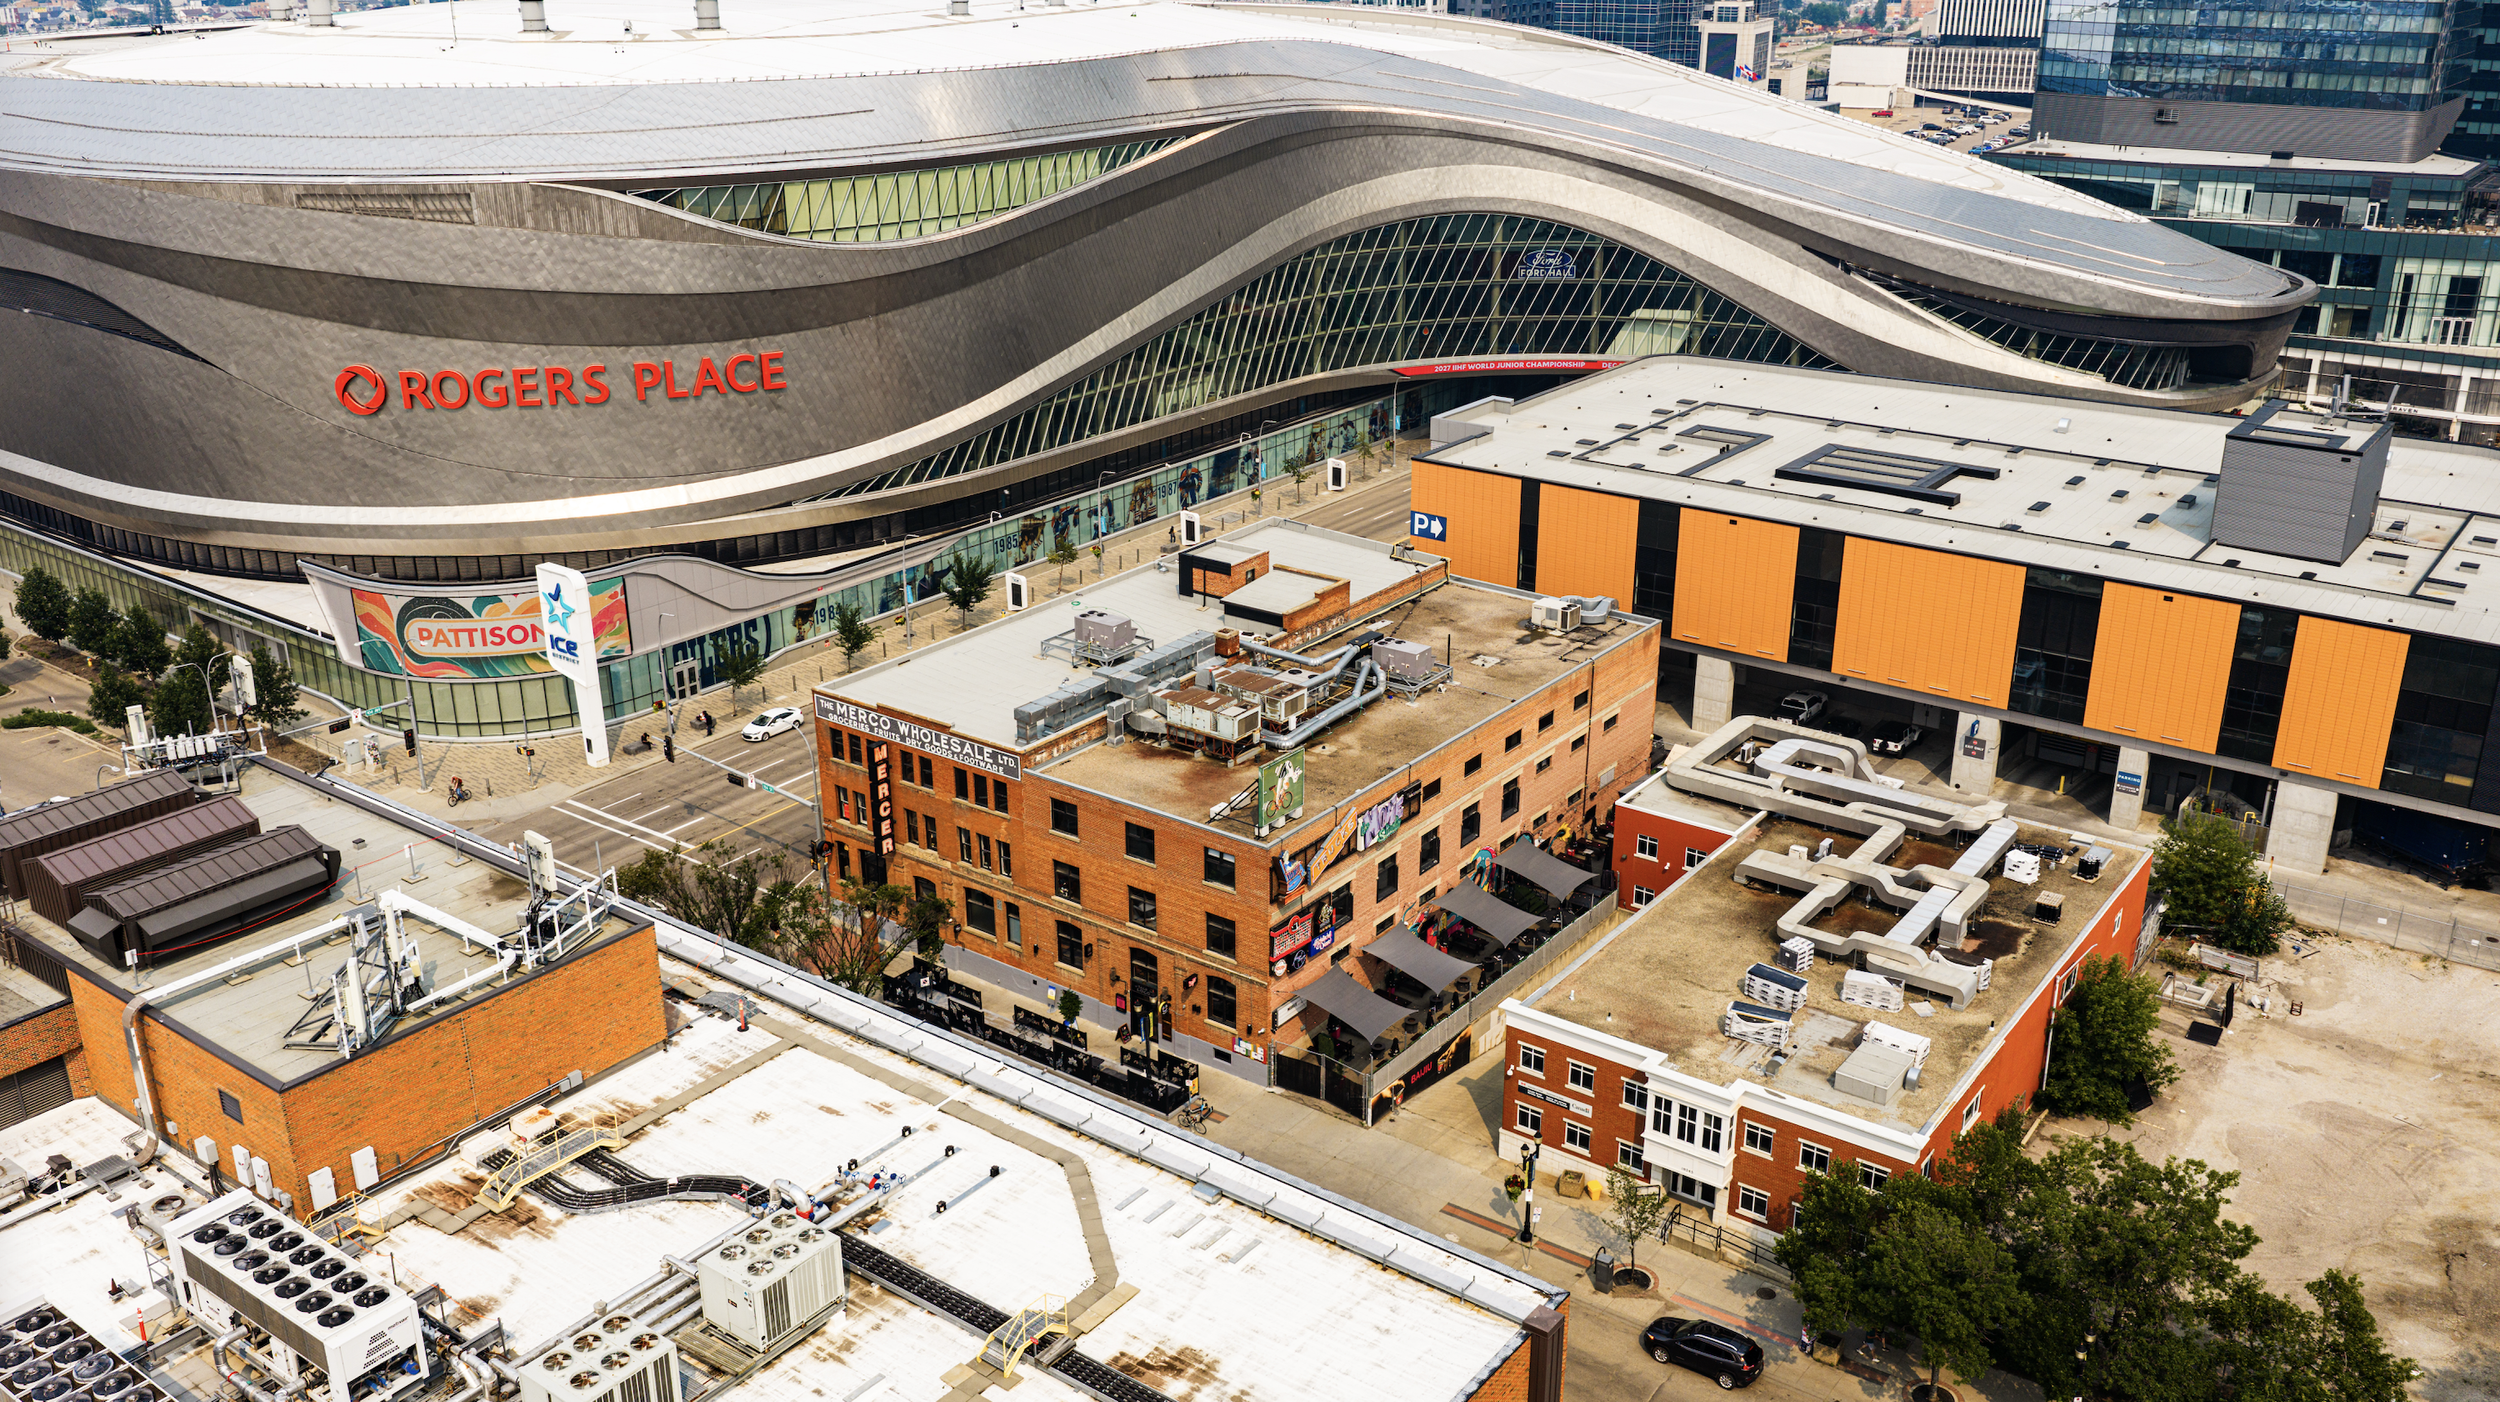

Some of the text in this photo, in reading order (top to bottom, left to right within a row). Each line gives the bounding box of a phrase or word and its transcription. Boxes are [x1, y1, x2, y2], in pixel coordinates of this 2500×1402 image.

[1532, 252, 1563, 266] Ford
[1520, 268, 1573, 277] FORD HALL
[1468, 362, 1496, 370] WORLD
[1496, 361, 1525, 369] JUNIOR
[398, 350, 787, 410] ROGERS PLACE
[1157, 482, 1177, 500] 1987
[1414, 513, 1429, 535] P
[994, 534, 1018, 555] 1985
[552, 652, 580, 665] DISTRICT
[819, 699, 1017, 769] THE MERCO WHOLESALE LTD.
[828, 713, 870, 732] GROCERIES
[874, 727, 900, 741] FRUITS
[906, 737, 922, 747] DRY
[924, 743, 953, 758] GOODS
[959, 754, 1004, 774] FOOTWARE
[2118, 774, 2141, 783] PARKING
[874, 744, 894, 856] MERCER
[1315, 819, 1354, 870] TRUCKS
[1410, 1061, 1433, 1084] BAIJIU
